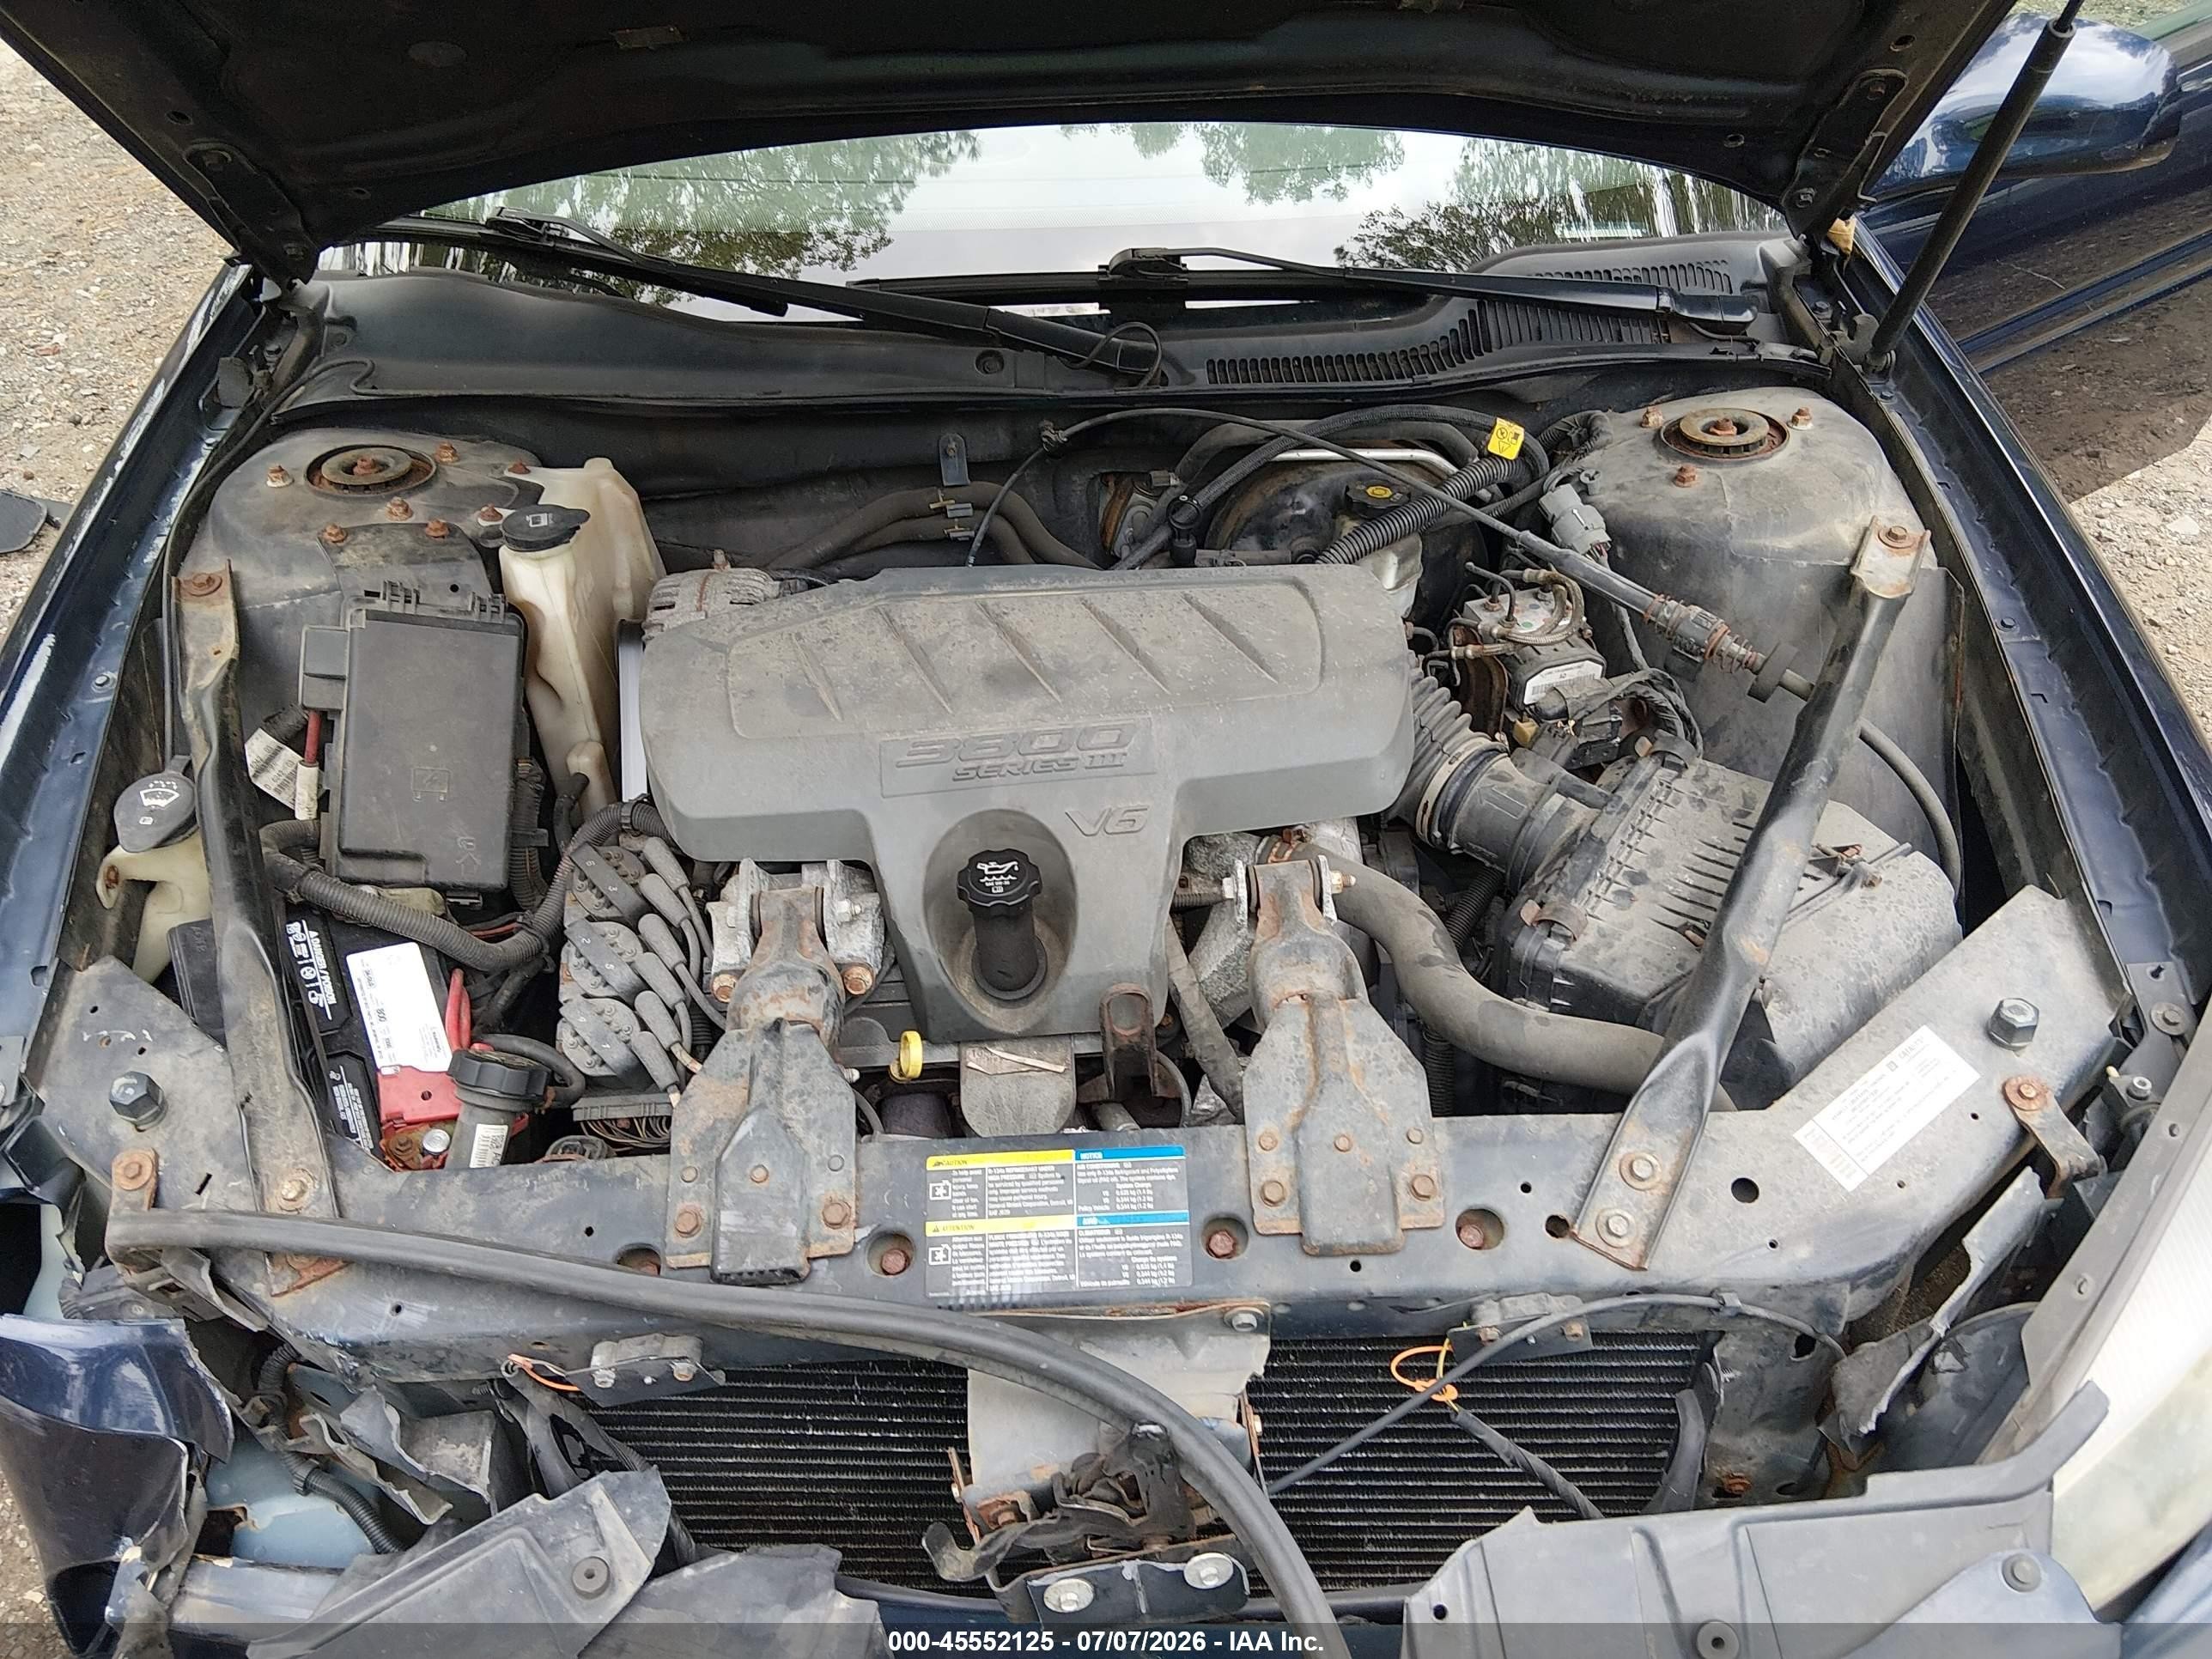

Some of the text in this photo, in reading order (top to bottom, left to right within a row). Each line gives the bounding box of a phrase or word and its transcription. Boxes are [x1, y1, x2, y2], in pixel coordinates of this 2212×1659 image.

[896, 723, 1136, 768] 3800
[952, 757, 1079, 781] SERIES
[1065, 805, 1148, 836] V6
